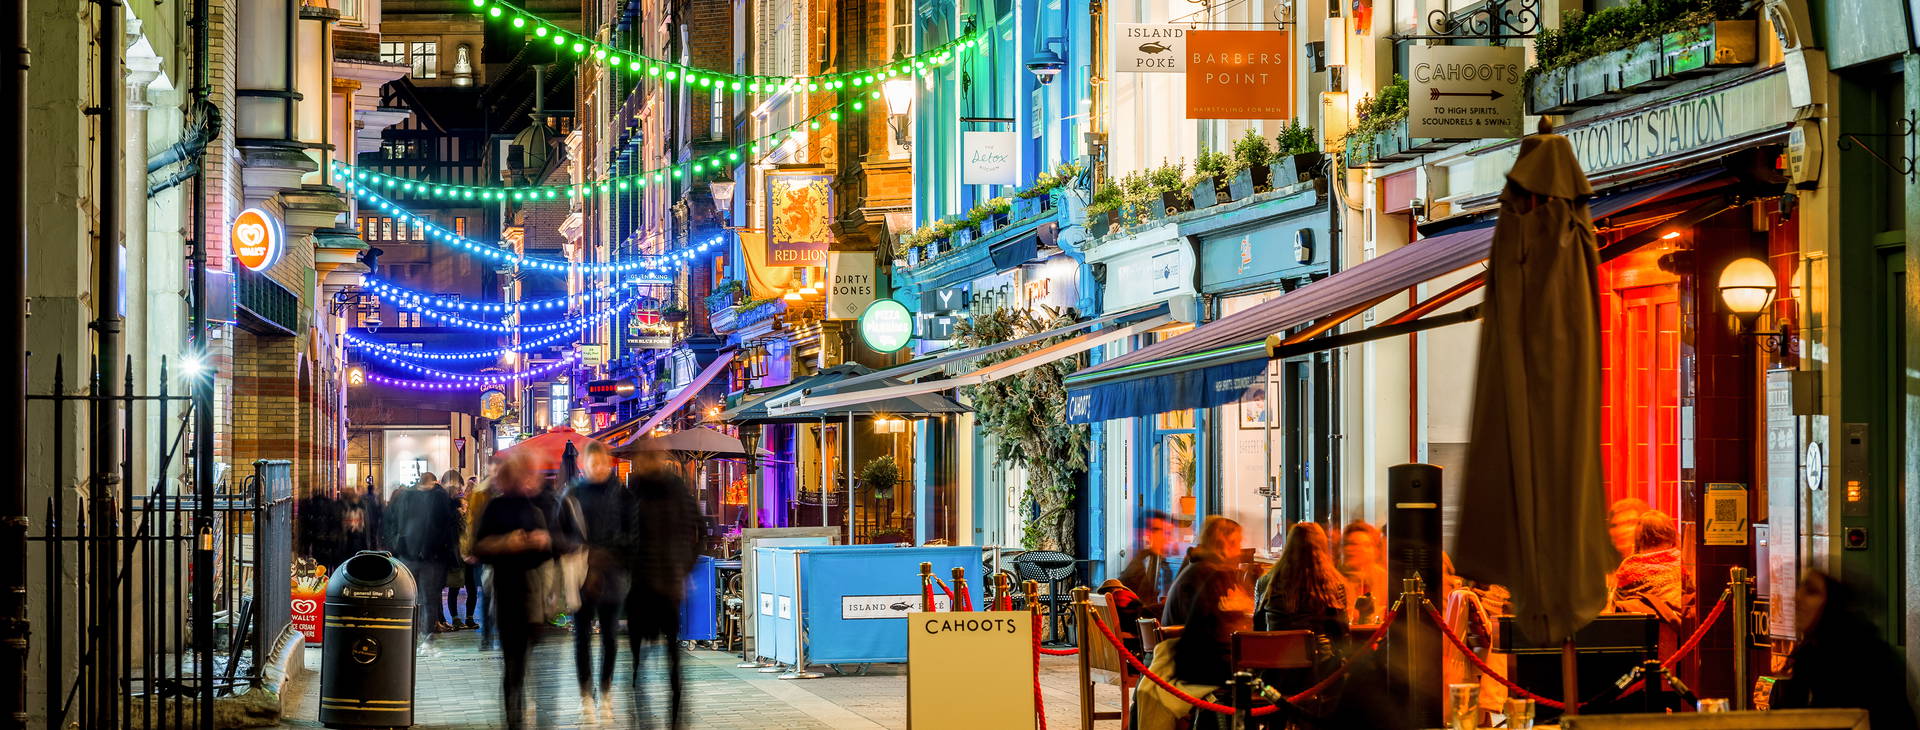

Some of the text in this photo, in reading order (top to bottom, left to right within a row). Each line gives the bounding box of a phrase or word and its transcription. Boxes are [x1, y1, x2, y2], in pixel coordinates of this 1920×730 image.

[1127, 28, 1183, 38] ISLAND
[1136, 55, 1175, 68] POKÉ
[1193, 52, 1282, 65] BARBERS
[1206, 72, 1269, 85] POINT
[1414, 62, 1519, 85] CAHOOTS
[1433, 106, 1445, 115] TO
[1447, 107, 1467, 115] HIGH
[1422, 117, 1473, 126] SCOUNDRELS
[1475, 118, 1482, 126] &
[1587, 114, 1644, 172] COURT
[1646, 92, 1725, 158] STATION
[775, 249, 828, 261] RED LION
[835, 274, 868, 284] DIRTY
[833, 286, 871, 296] BONES
[939, 289, 953, 309] Y
[938, 317, 951, 337] T
[848, 601, 945, 611] ISLAND PÉ
[291, 614, 316, 622] WALL'S
[925, 618, 1016, 635] CAHOOTS
